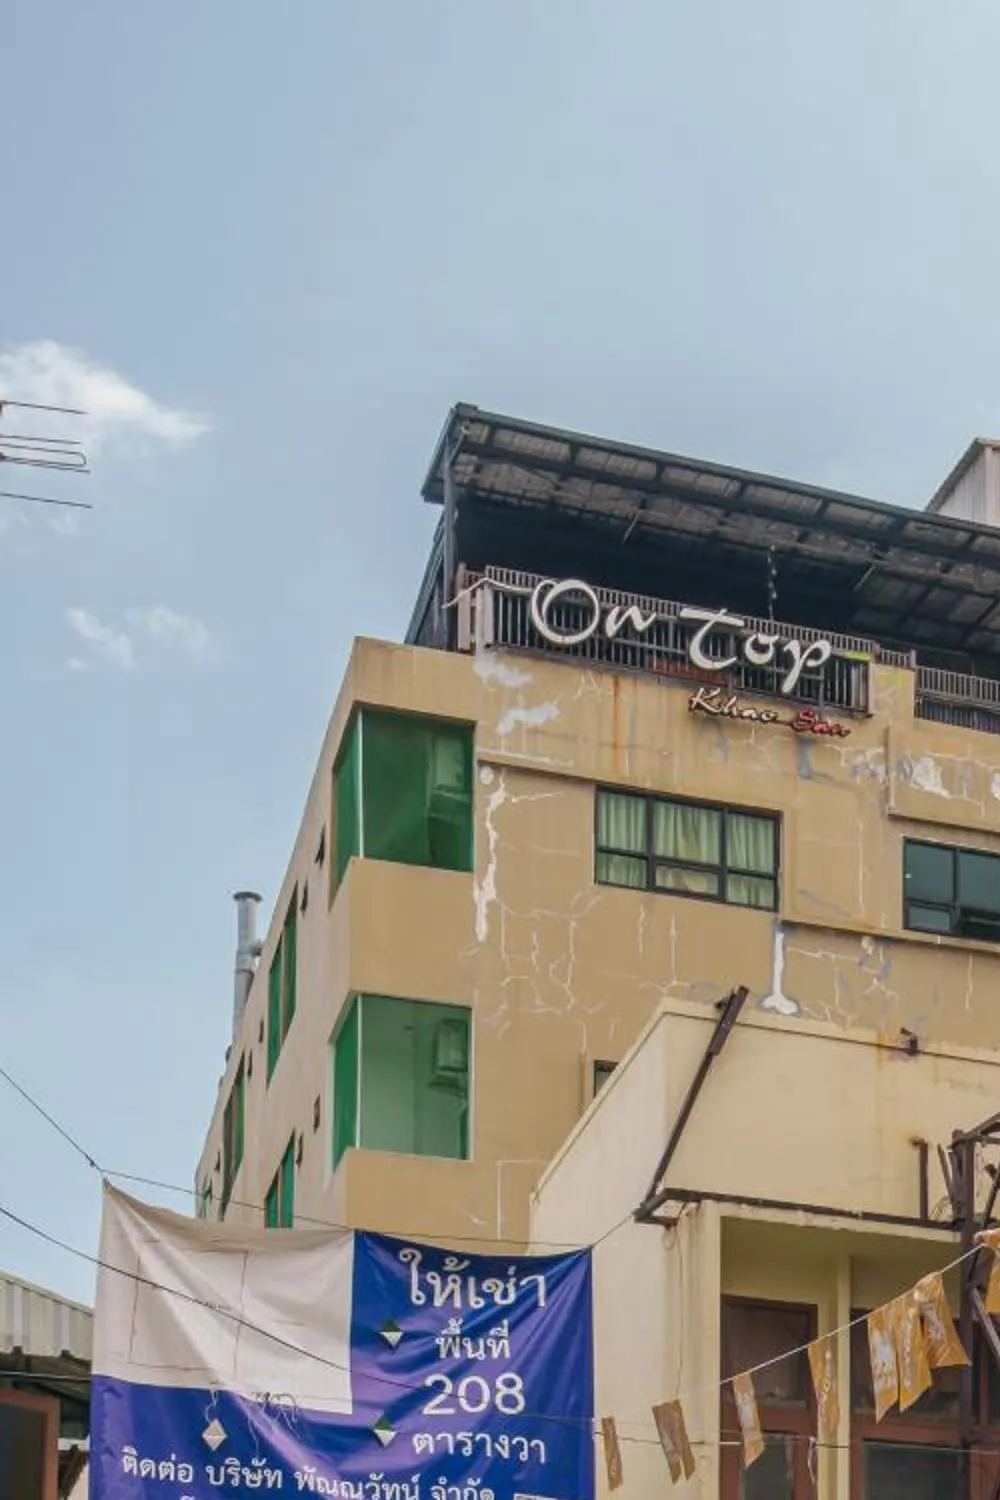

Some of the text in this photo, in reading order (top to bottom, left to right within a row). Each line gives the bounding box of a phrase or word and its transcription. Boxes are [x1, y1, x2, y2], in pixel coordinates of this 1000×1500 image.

[531, 579, 832, 694] On Top
[400, 1249, 546, 1309] ให้เช่า
[435, 1318, 511, 1360] พื้นที่
[422, 1373, 526, 1415] 208
[121, 1445, 194, 1483] ติดต่อ
[205, 1457, 283, 1490] บริษัท
[412, 1431, 546, 1464] ตารางวา
